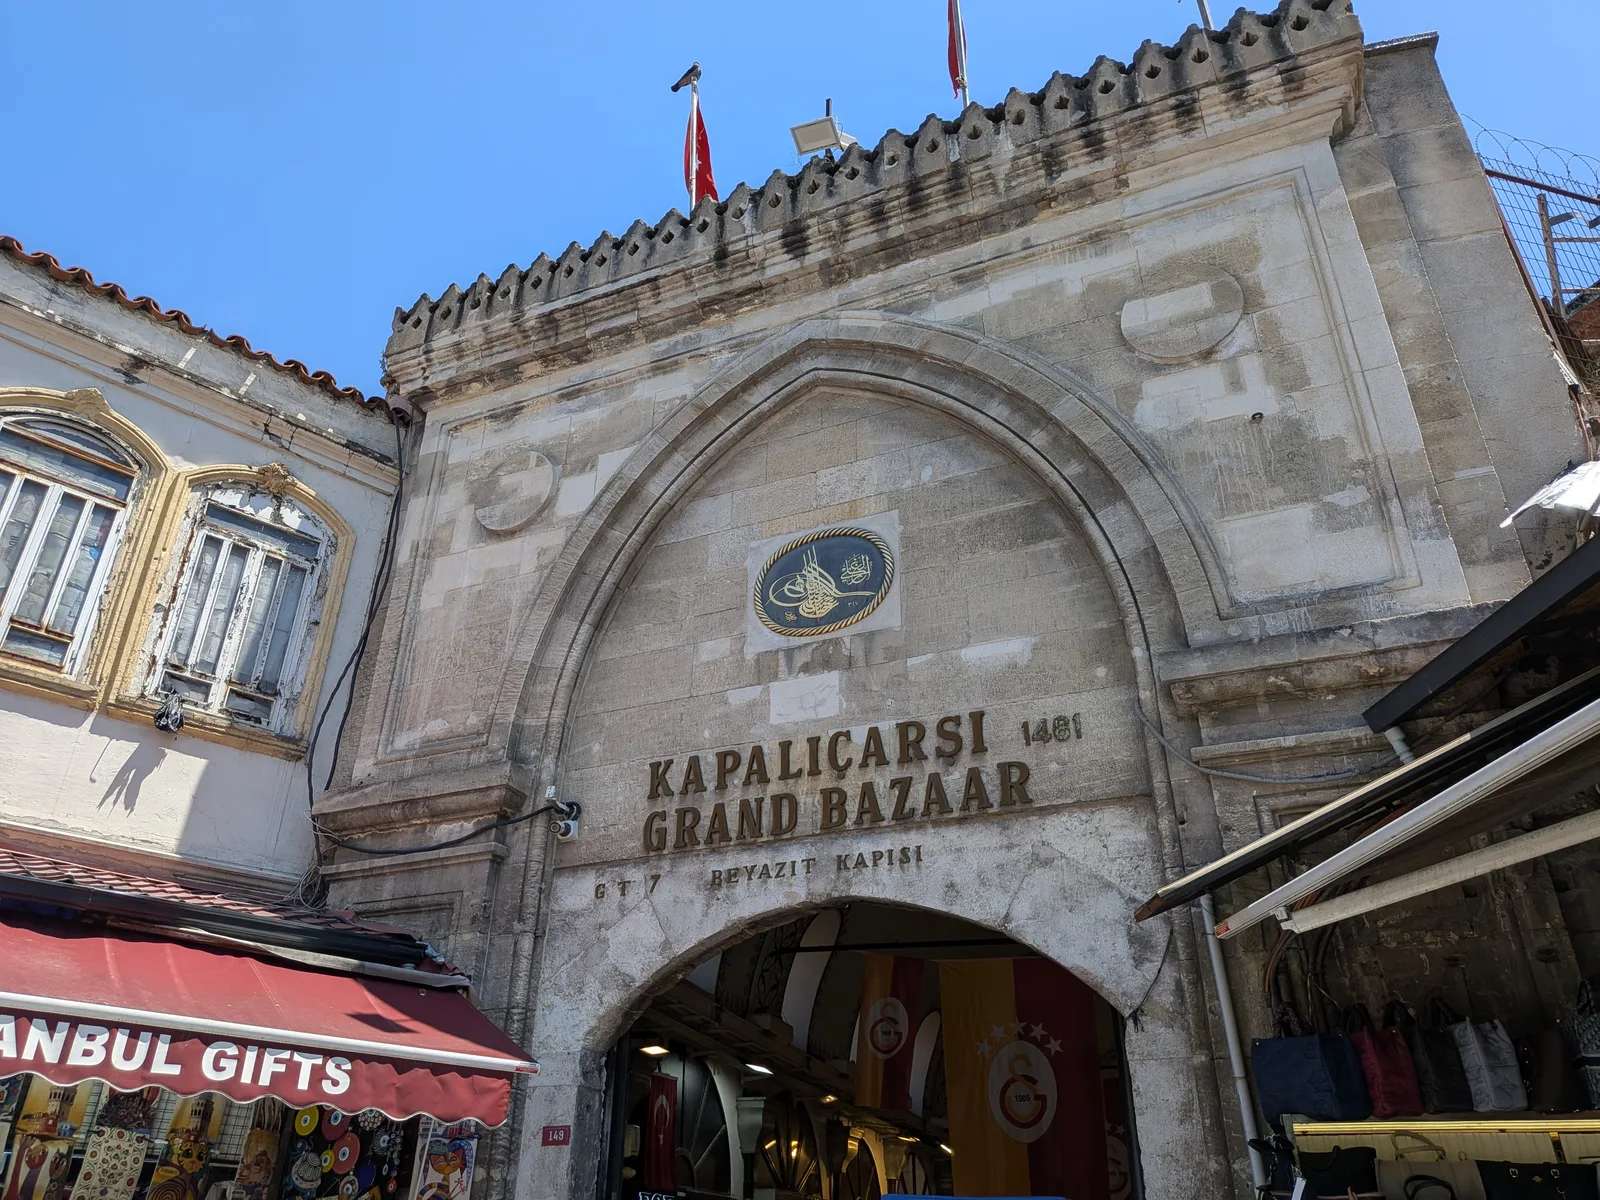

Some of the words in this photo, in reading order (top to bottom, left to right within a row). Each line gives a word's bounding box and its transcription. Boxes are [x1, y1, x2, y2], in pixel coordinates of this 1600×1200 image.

[647, 710, 988, 800] KAPALIÇARŞI
[643, 792, 798, 851] GRAND
[819, 761, 1032, 830] BAZAAR
[649, 874, 661, 894] 7
[710, 857, 816, 887] BEYAZIT
[201, 1041, 352, 1095] GIFTS
[548, 1130, 564, 1141] 149
